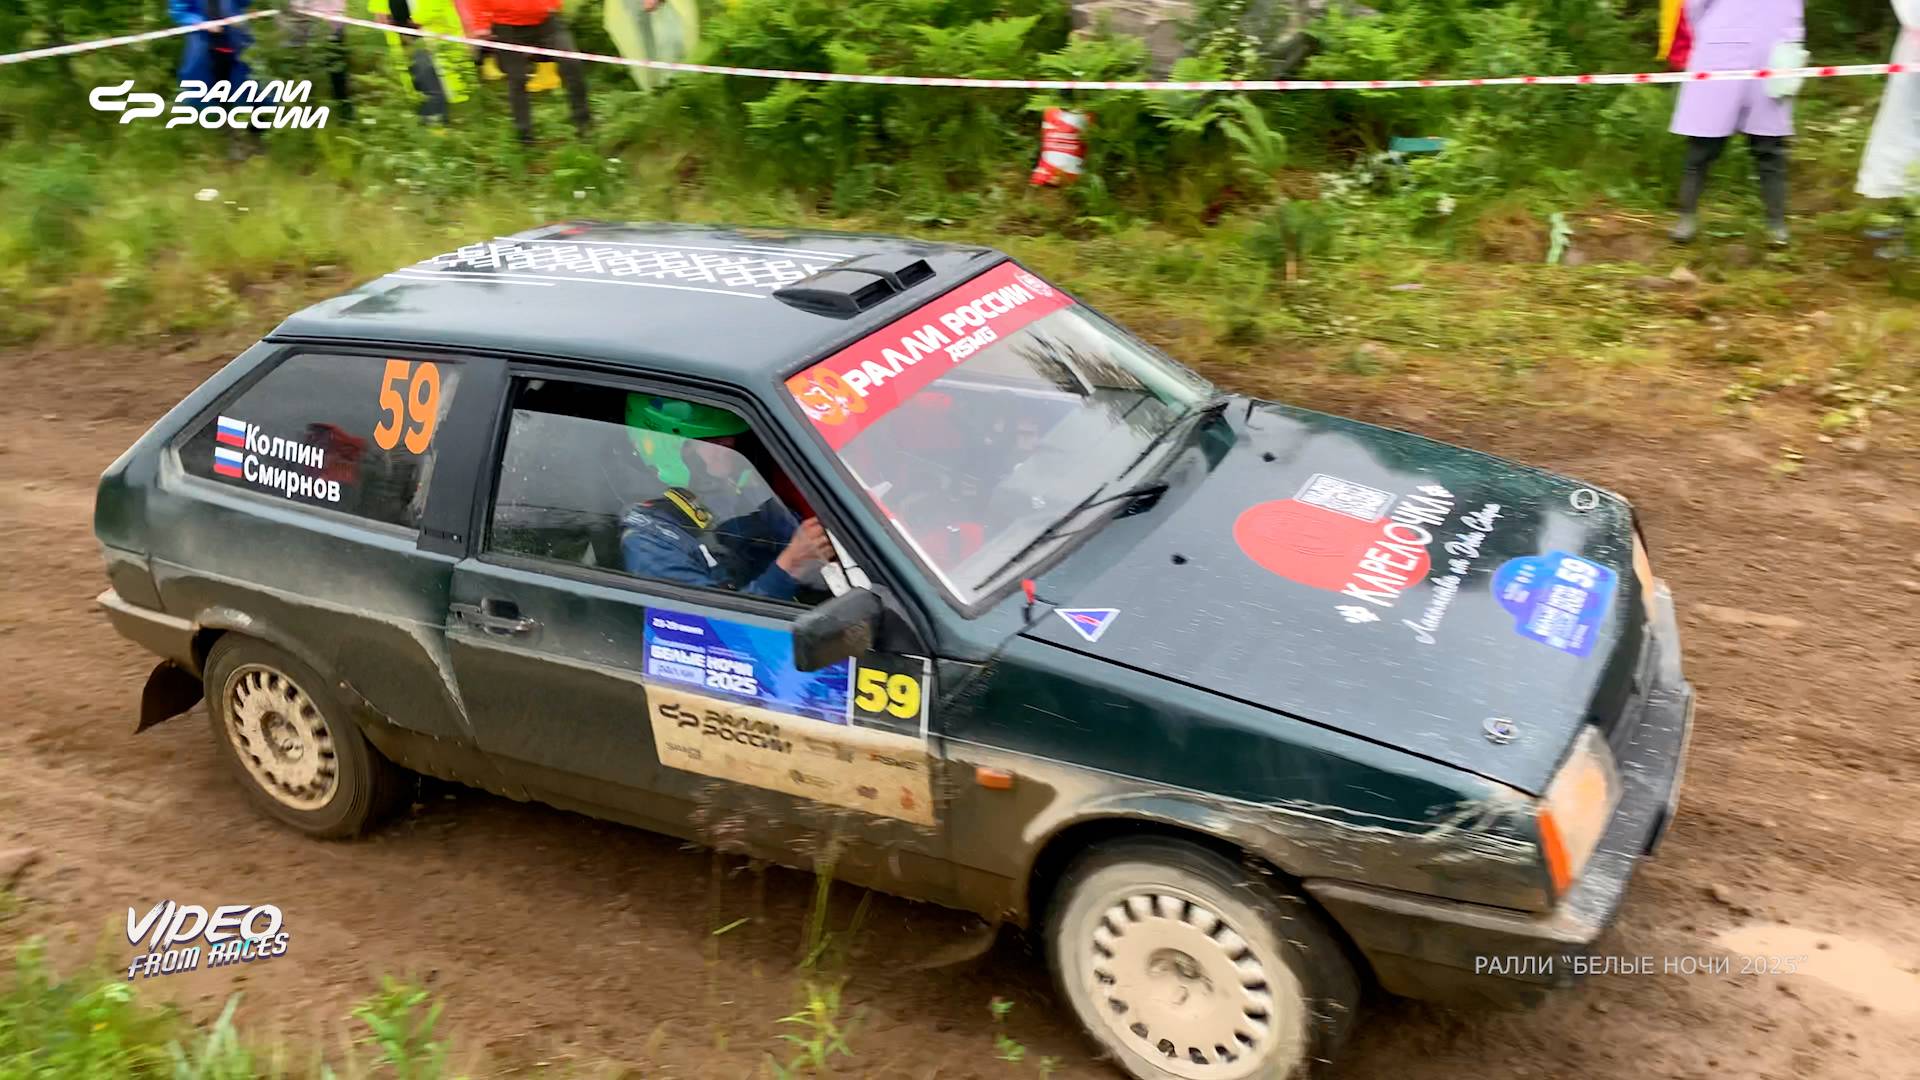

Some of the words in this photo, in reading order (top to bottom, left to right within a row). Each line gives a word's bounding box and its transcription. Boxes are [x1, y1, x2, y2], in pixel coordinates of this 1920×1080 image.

[840, 324, 952, 398] РАЛЛИ
[938, 283, 1036, 337] РОССИИ
[373, 359, 441, 454] 59
[244, 422, 324, 469] Колпин
[243, 454, 341, 502] Смирнов
[1555, 557, 1600, 589] 59
[706, 669, 758, 696] 2025
[855, 667, 920, 719] 59
